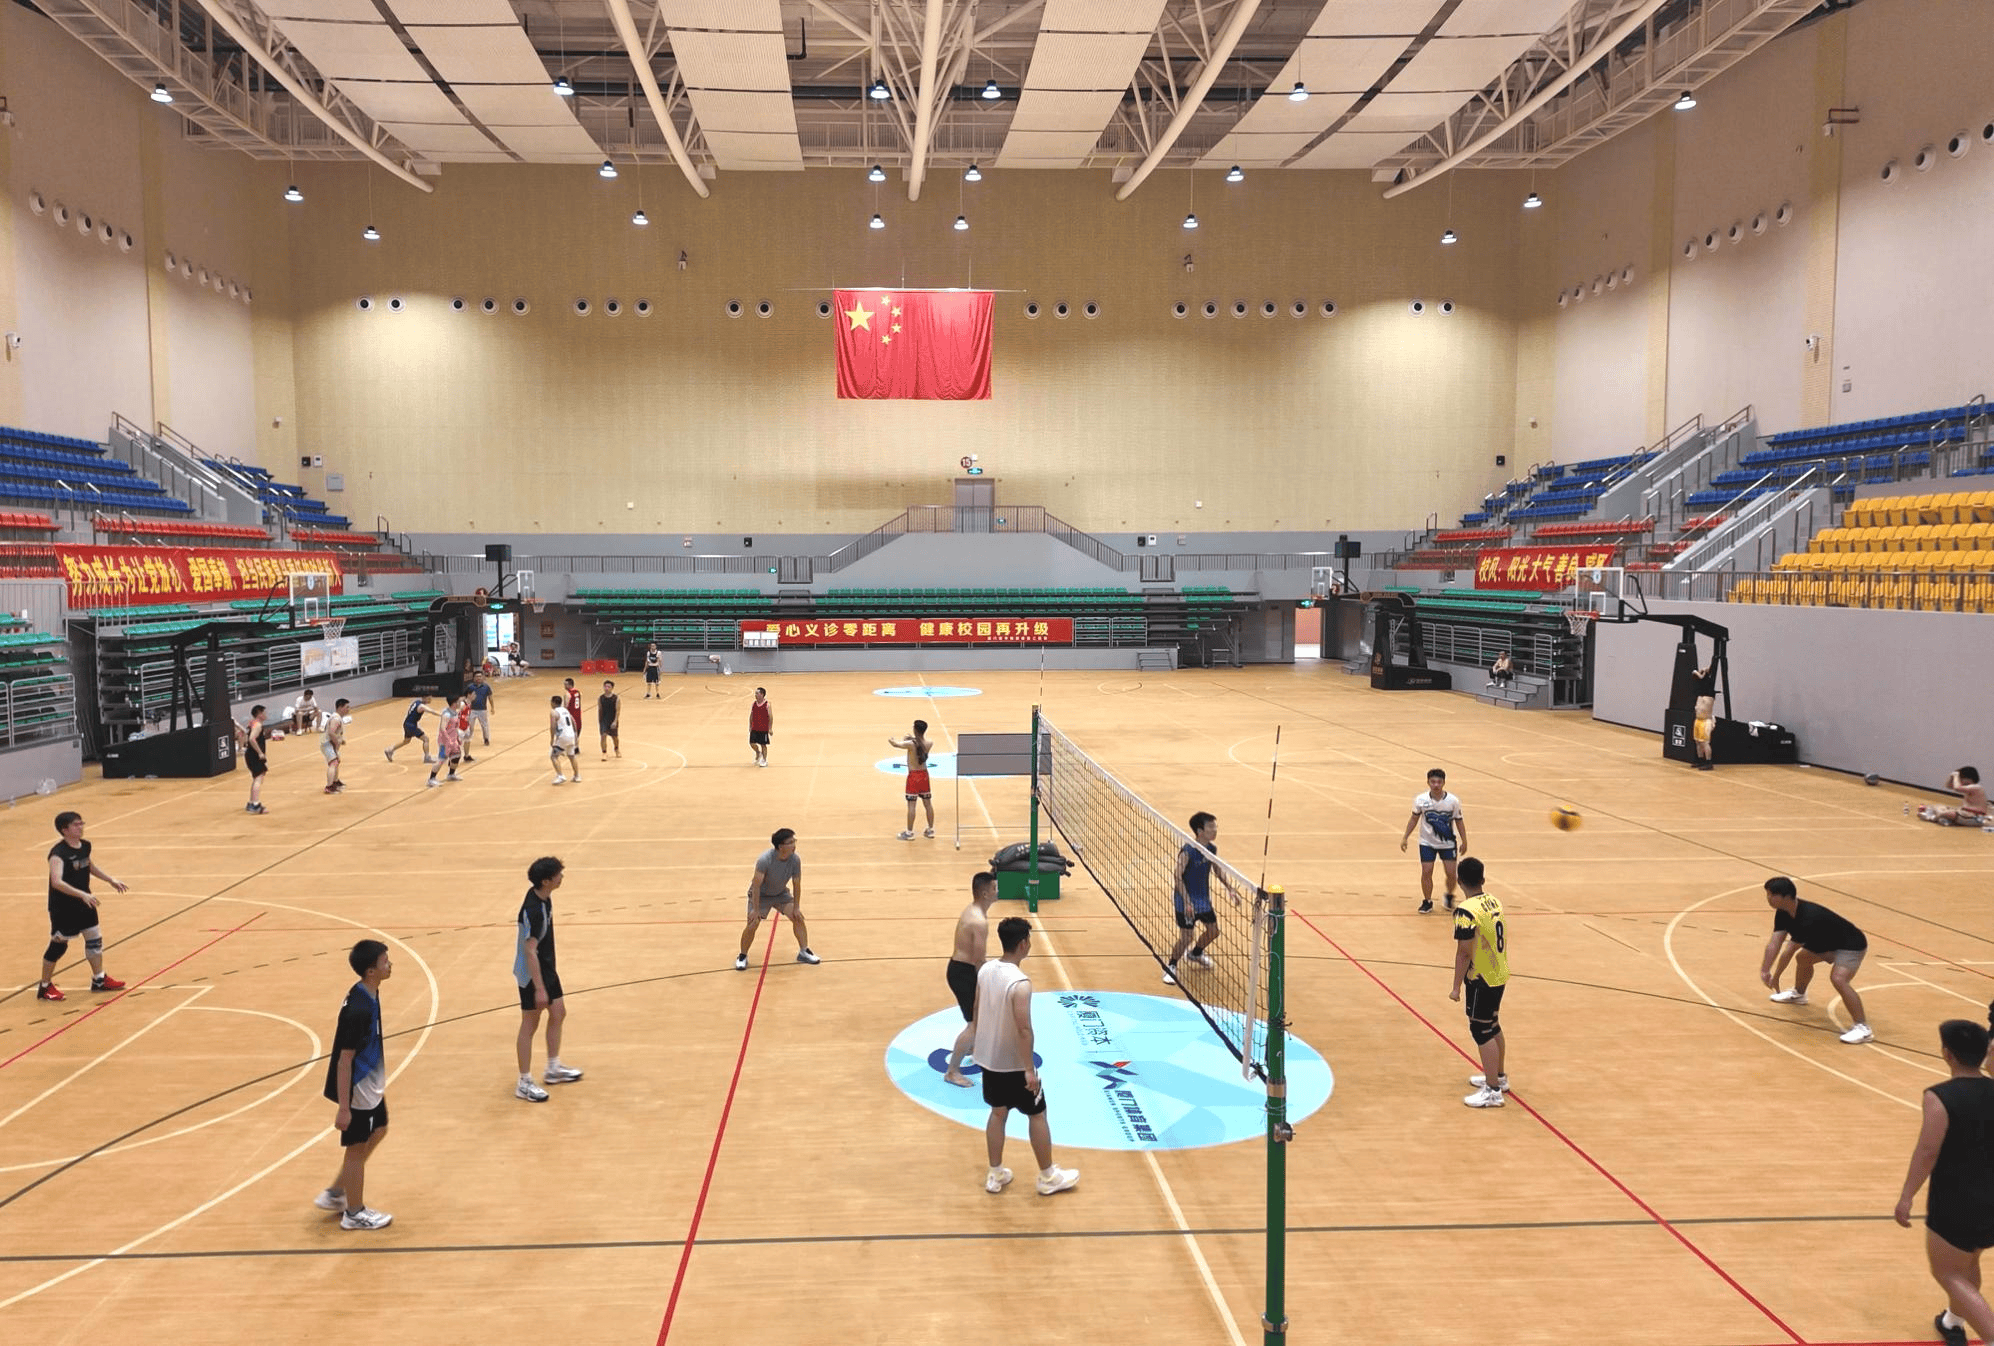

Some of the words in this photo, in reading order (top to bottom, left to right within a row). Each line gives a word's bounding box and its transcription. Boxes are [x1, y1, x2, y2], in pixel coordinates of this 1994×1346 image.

[919, 621, 1049, 637] 健康校园再升级
[1496, 920, 1504, 953] 8
[1114, 1090, 1158, 1142] 厦门体育集团
